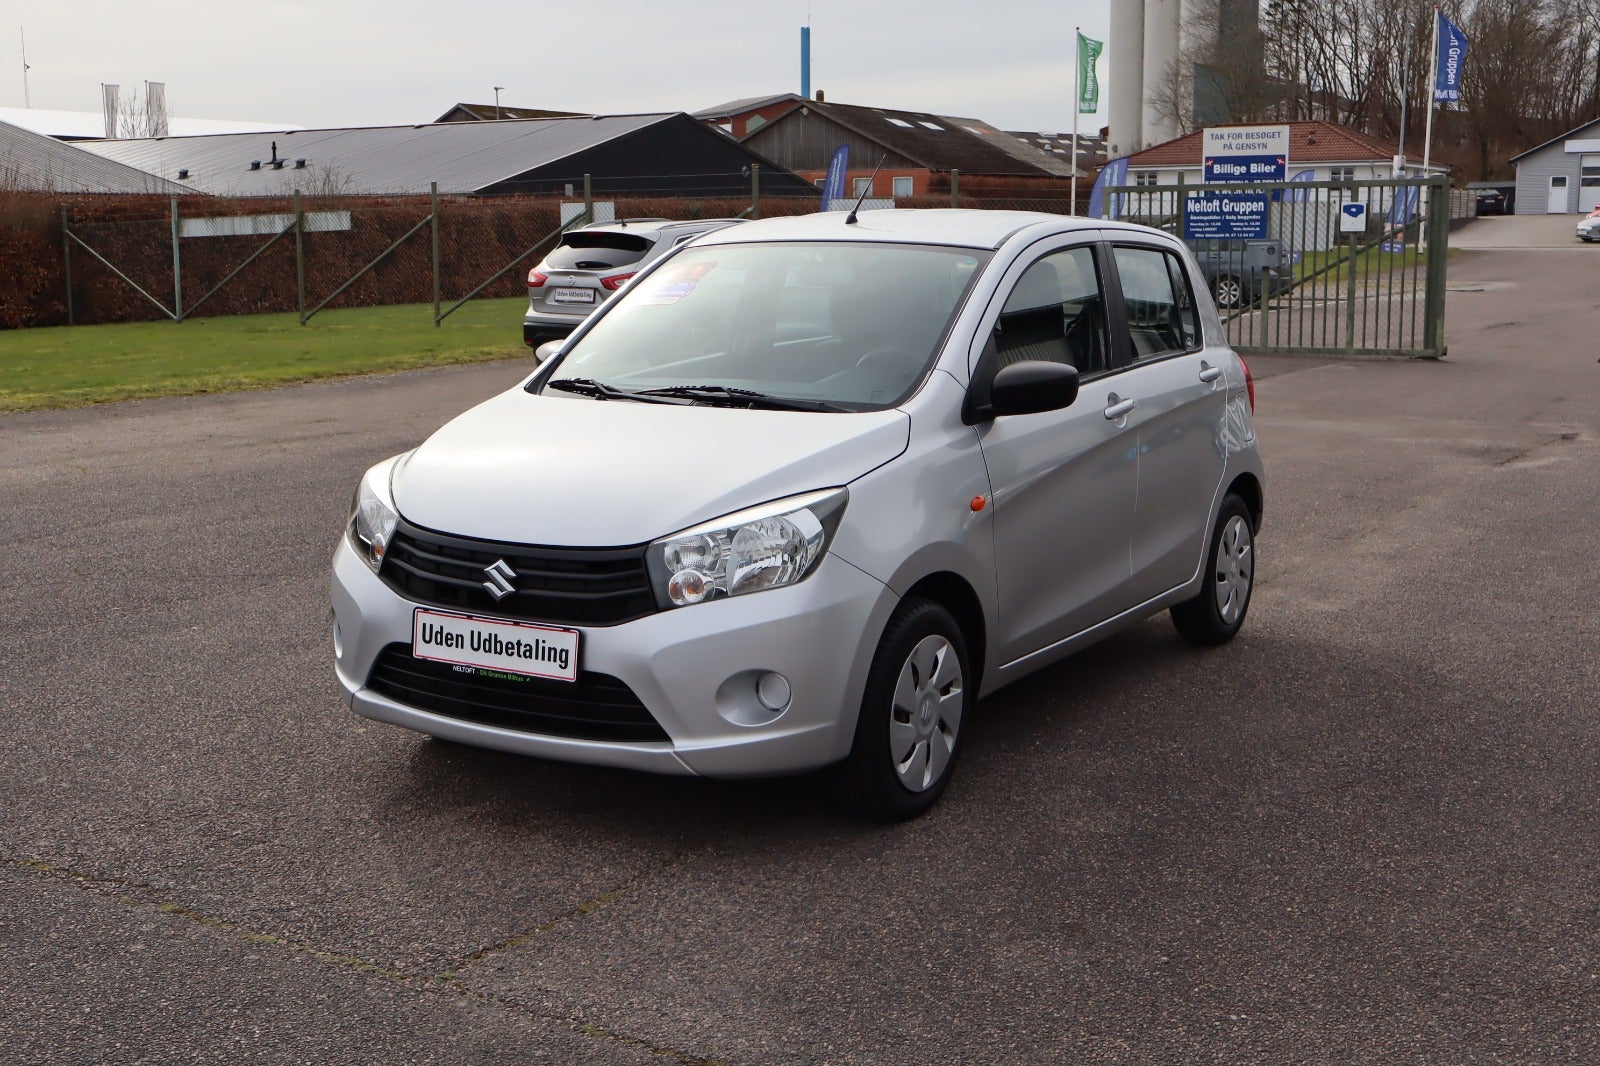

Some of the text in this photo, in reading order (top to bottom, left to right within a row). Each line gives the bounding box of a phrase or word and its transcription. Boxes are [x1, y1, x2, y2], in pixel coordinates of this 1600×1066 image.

[1446, 47, 1460, 85] Gruppen
[1227, 132, 1243, 140] FOR
[1245, 131, 1282, 140] BESØGET
[1223, 142, 1268, 150] PÅ GENSYN
[1213, 163, 1277, 175] Billige Biler
[1187, 199, 1264, 214] Neltoft Gruppen
[421, 622, 569, 670] Uden Udbetaling
[452, 665, 476, 675] NELTOFT
